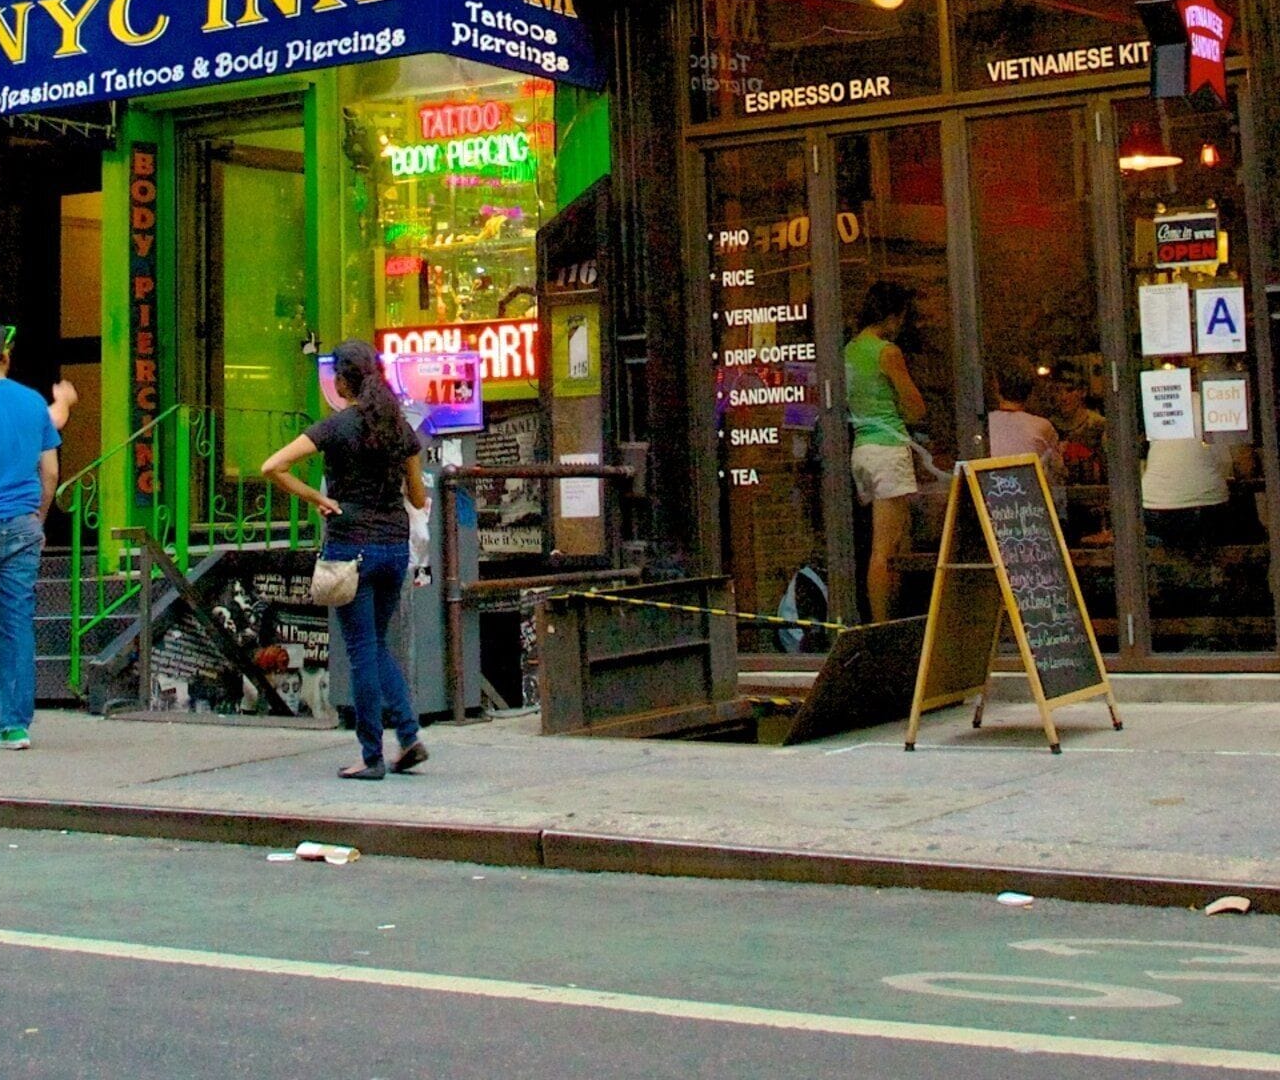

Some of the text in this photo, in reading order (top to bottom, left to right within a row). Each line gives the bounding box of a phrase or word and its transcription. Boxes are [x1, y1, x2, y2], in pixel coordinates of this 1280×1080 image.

[465, 1, 558, 46] Tattoos
[101, 60, 184, 93] Tattoos
[191, 57, 209, 80] &
[215, 37, 278, 78] Body
[284, 25, 408, 69] Piercings
[452, 22, 570, 73] Piercings
[987, 41, 1151, 82] VIETNAMESE KIT
[745, 76, 891, 113] ESPRESSO BAR
[420, 102, 501, 139] TATTOO
[391, 132, 529, 176] BODY PIERCING
[720, 230, 749, 247] PHO
[1158, 241, 1217, 262] OPEN
[557, 260, 598, 286] 116
[722, 269, 755, 287] RICE
[130, 152, 161, 495] BODY PIERCING
[724, 304, 808, 326] VERMICELLI
[1206, 297, 1236, 334] A
[478, 323, 539, 379] ART
[724, 343, 816, 366] DRIP COFFEE
[729, 386, 804, 407] SANDWICH
[1207, 386, 1240, 400] Cash
[1208, 410, 1241, 425] Only
[731, 428, 778, 445] SHAKE
[731, 469, 759, 485] TEA
